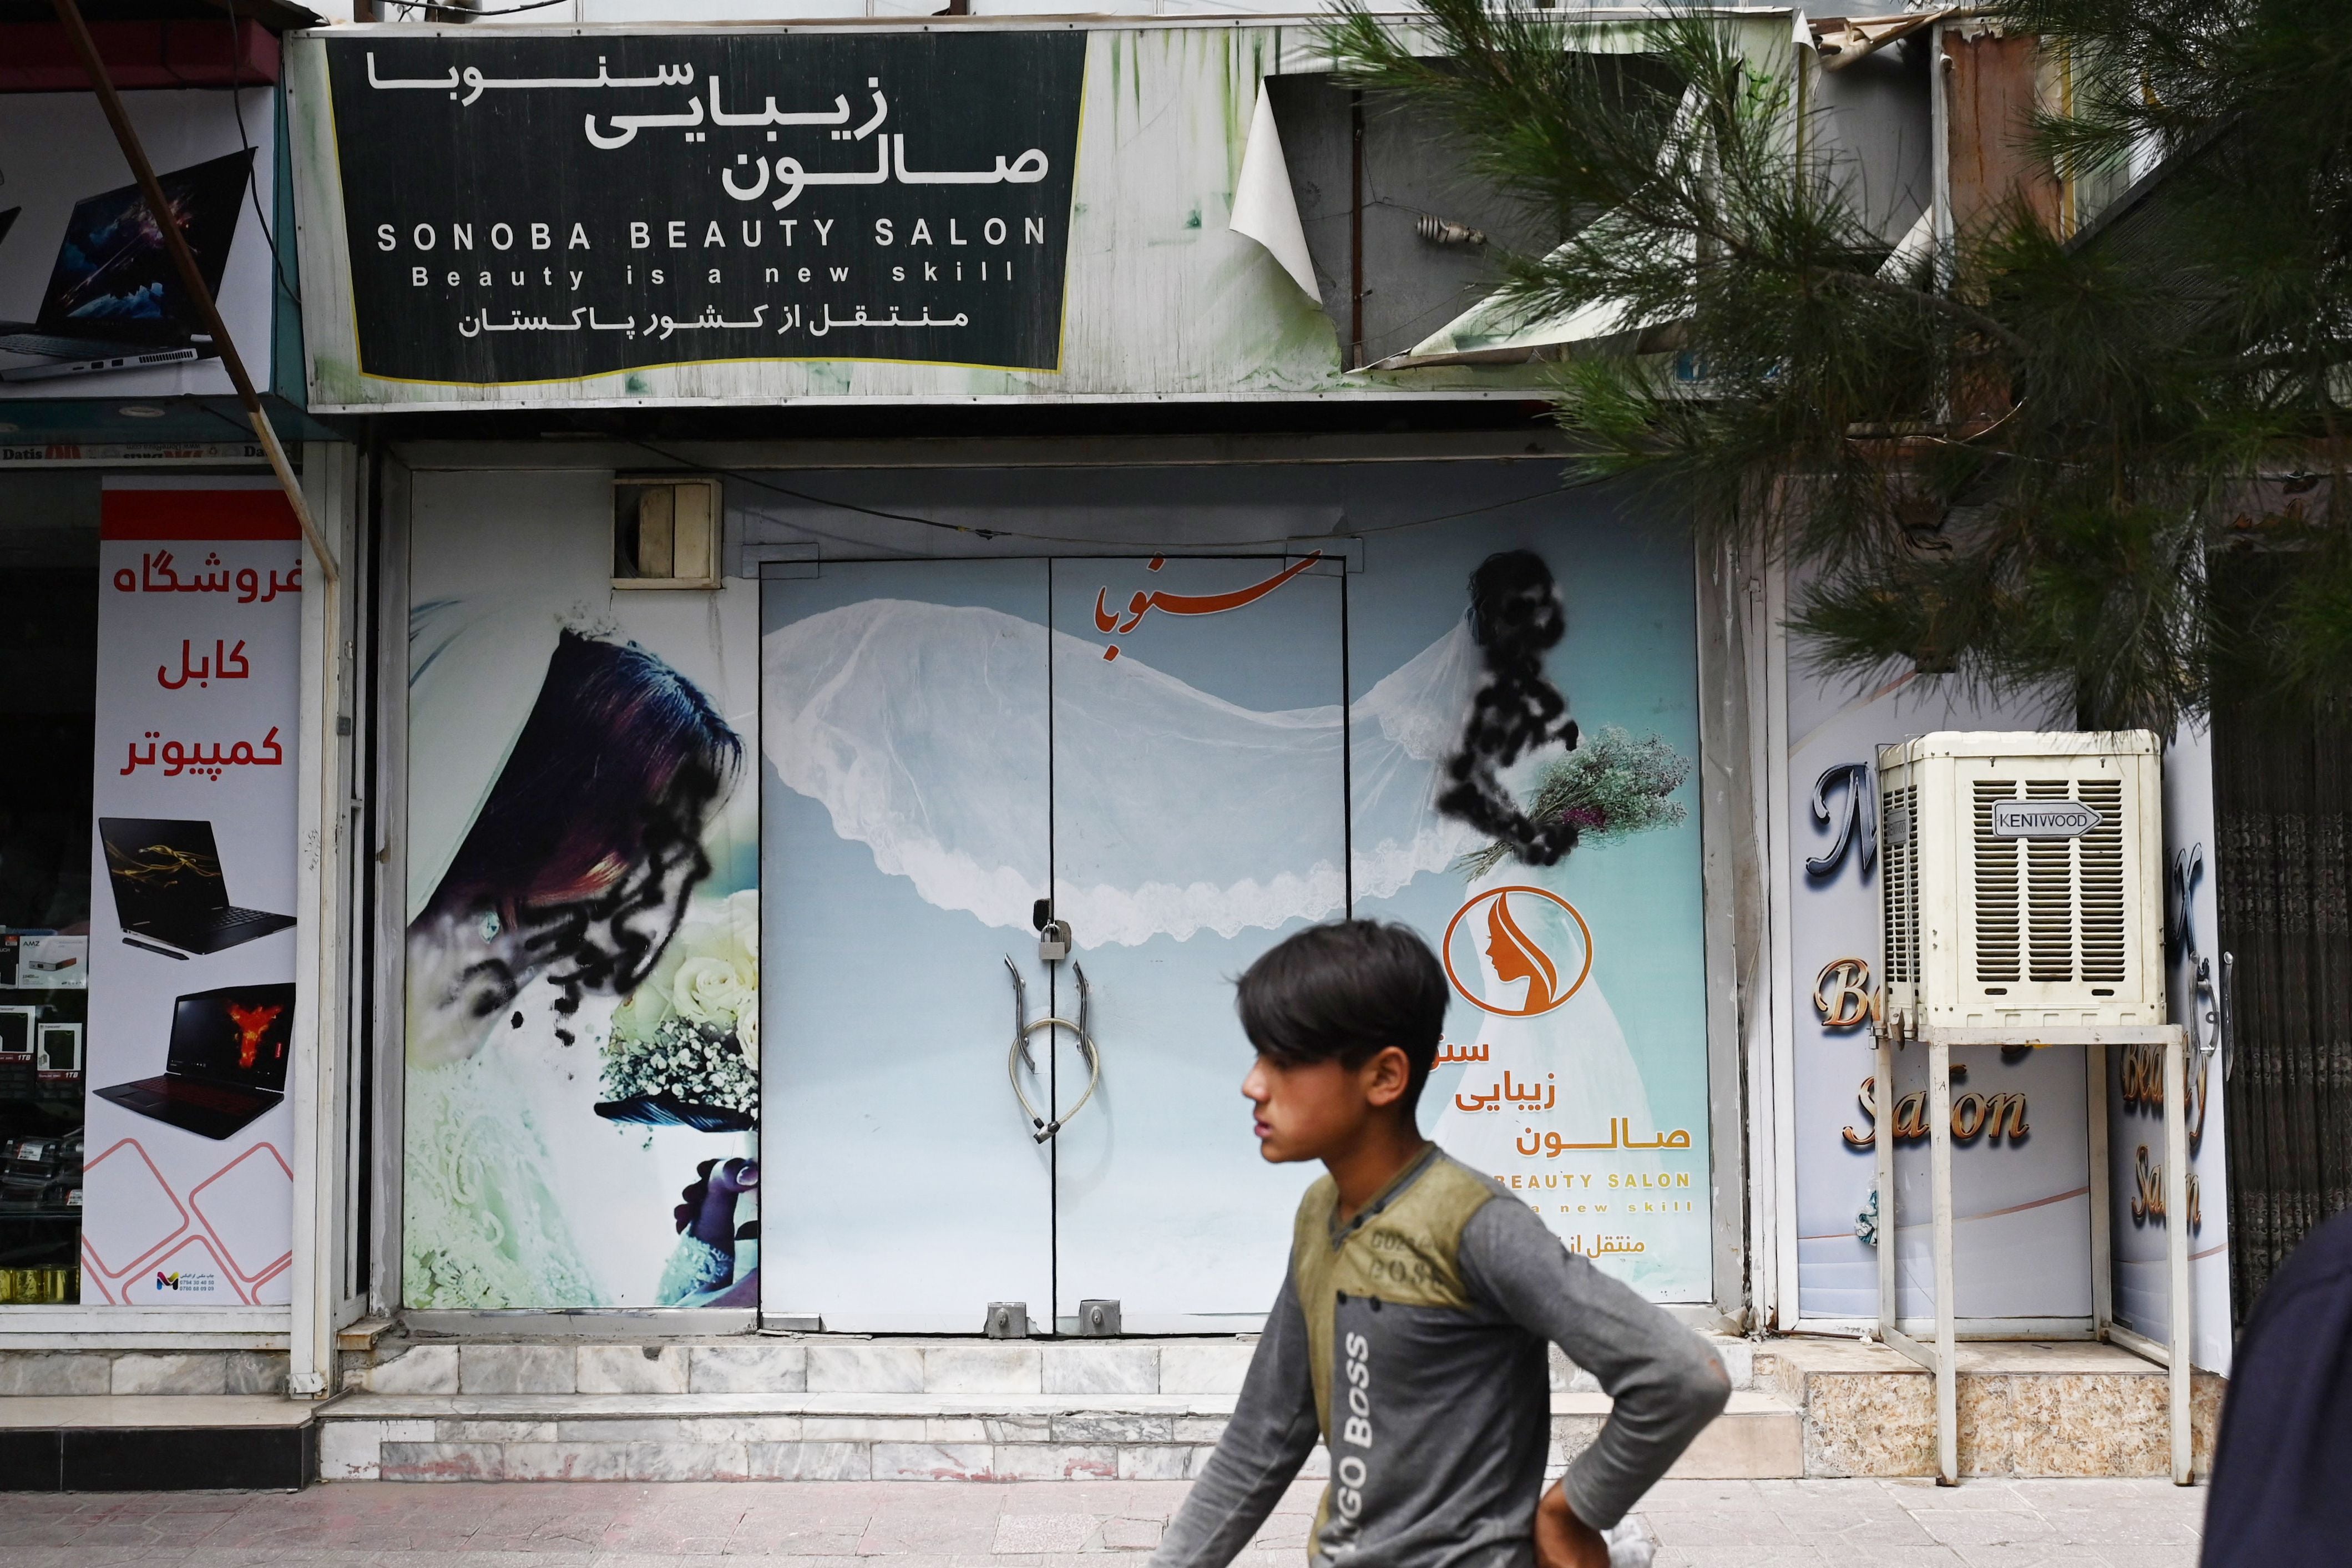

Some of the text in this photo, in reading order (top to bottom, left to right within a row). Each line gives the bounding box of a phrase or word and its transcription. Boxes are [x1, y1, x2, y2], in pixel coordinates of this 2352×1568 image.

[366, 53, 694, 106] سنوبا
[584, 75, 888, 150] زیبایی
[722, 133, 1049, 211] صالون
[378, 217, 1044, 251] SONOBA BEAUTY SALON
[412, 261, 1012, 291] Beauty is a new skill
[458, 304, 969, 340] منتقل از کشور پاکستان
[2, 448, 42, 460] Datis
[114, 549, 302, 603] فروشگاه
[1094, 550, 1322, 662] سنوبا
[158, 639, 250, 689] کابل
[120, 726, 282, 781] کمپیوتر
[1455, 1070, 1555, 1111] زیبایی
[1842, 1064, 2030, 1145] Saon
[2120, 1031, 2207, 1139] Beaty
[1516, 1117, 1691, 1159] صالون
[1609, 1173, 1690, 1188] SALON
[2131, 1145, 2201, 1225] San
[1628, 1202, 1691, 1212] skill
[1586, 1234, 1645, 1259] منتقل
[1344, 1332, 1373, 1449] BOSS
